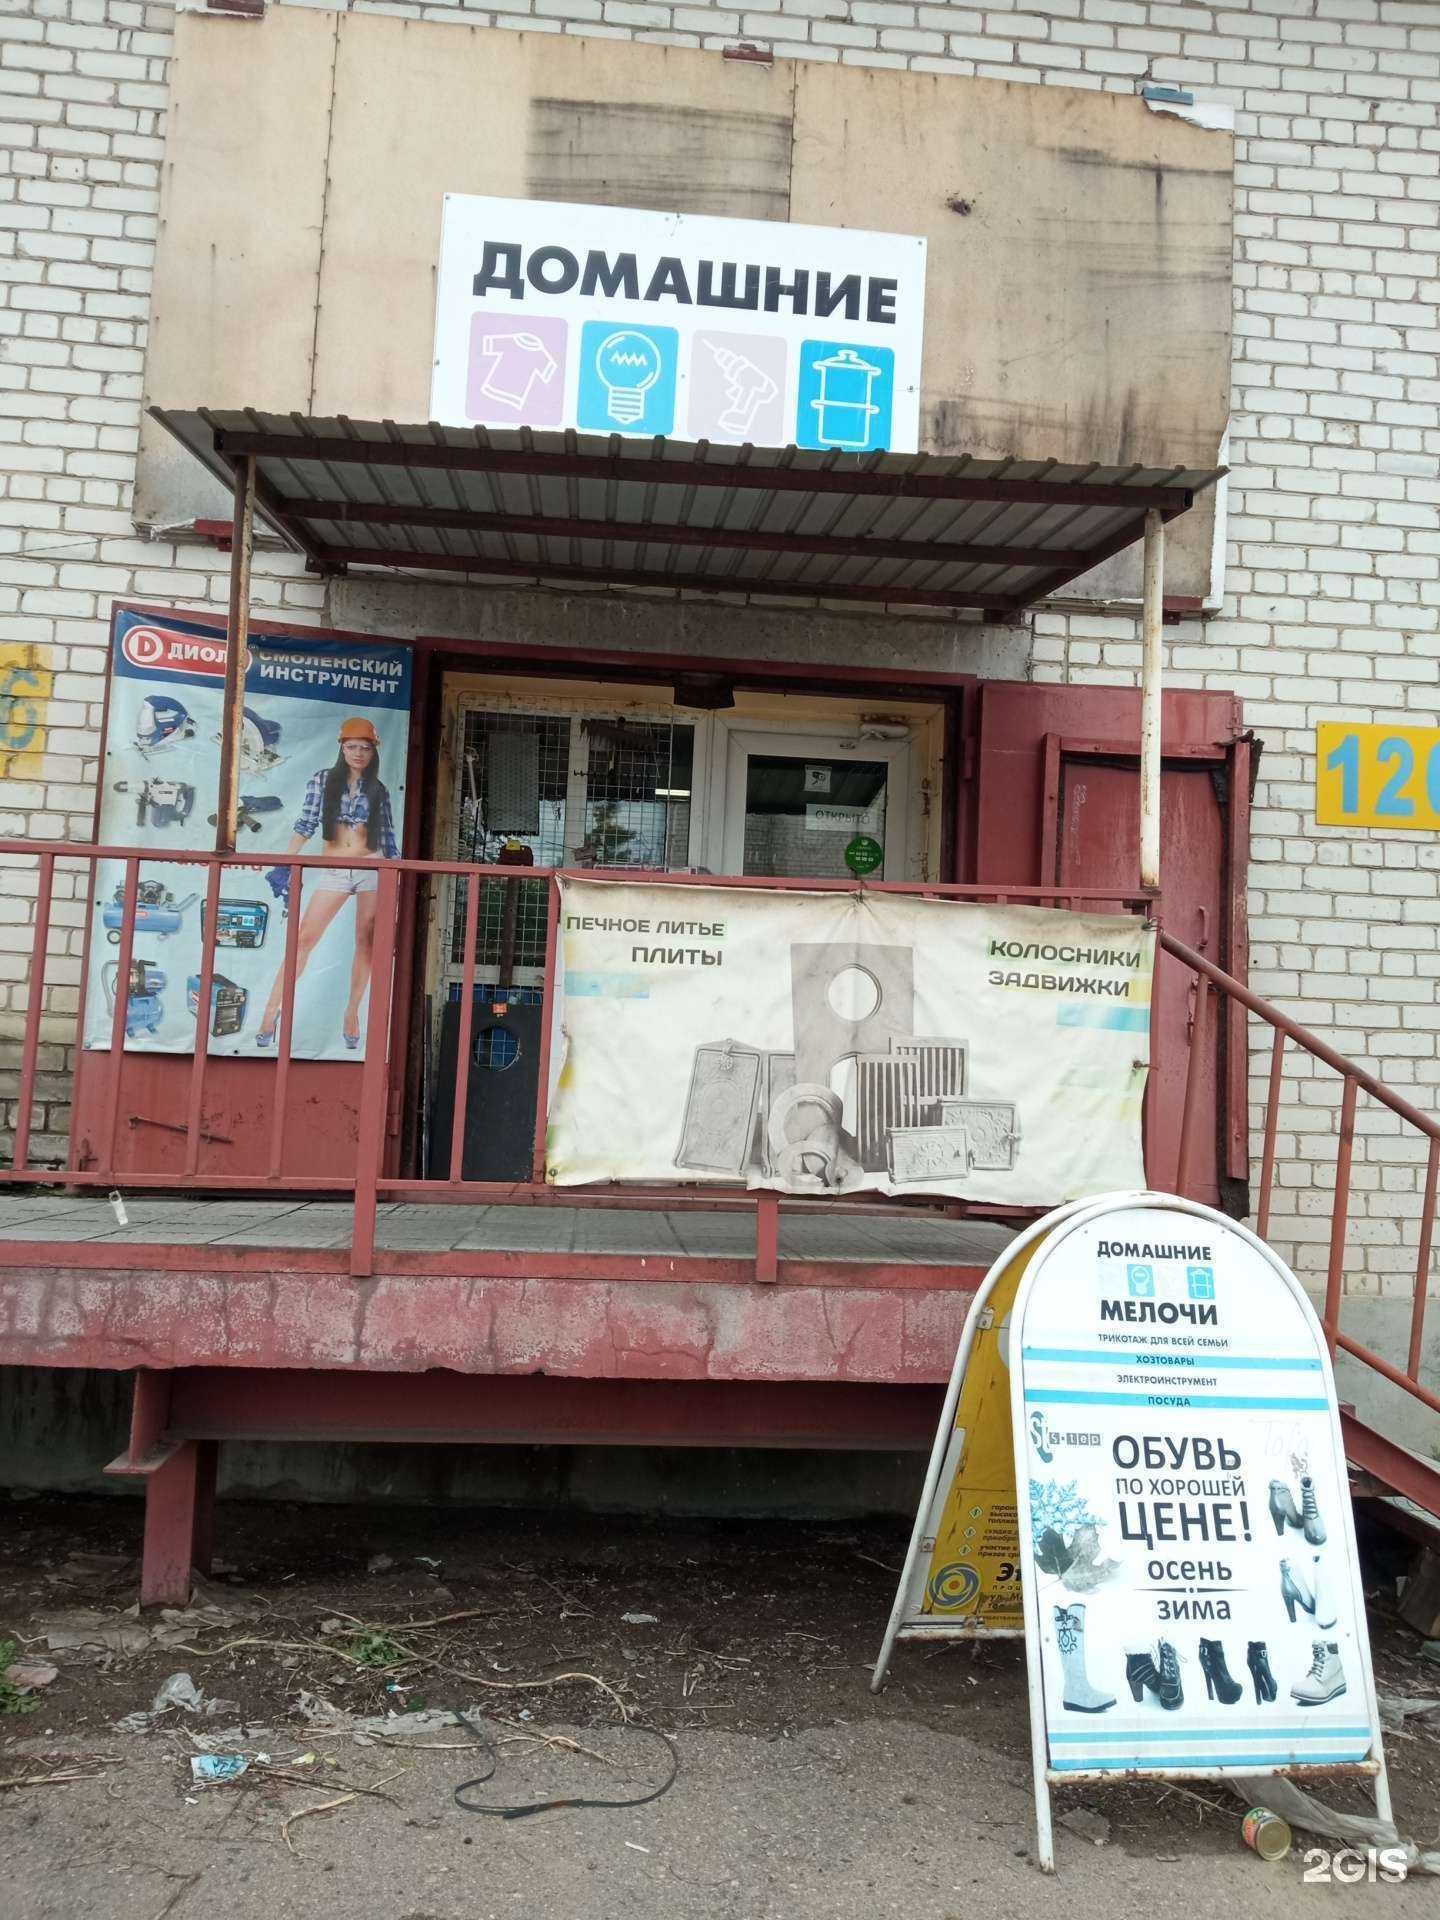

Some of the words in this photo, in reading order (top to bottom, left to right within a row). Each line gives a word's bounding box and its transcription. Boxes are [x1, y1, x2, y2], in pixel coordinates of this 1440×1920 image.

[472, 241, 898, 324] ДОМАШНИЕ
[167, 642, 228, 664] ДИОЛ
[259, 651, 402, 677] СМОЛЕНСКИЙ
[260, 664, 399, 694] ИНСТРУМЕНТ
[566, 916, 650, 934] ПЕЧНОЕ
[656, 919, 725, 937] ЛИТЬЕ
[631, 946, 723, 967] ПЛИТЫ
[989, 940, 1141, 969] КОЛОСНИКИ
[988, 970, 1130, 998] ЗАДВИЖКИ
[1097, 1241, 1212, 1261] ДОМАШНИЕ
[1100, 1300, 1218, 1326] МЕЛОЧИ
[1098, 1333, 1148, 1344] ТРИКОТАЖ
[1150, 1336, 1169, 1346] ДЛЯ
[1171, 1335, 1195, 1347] ВСЕЙ
[1197, 1337, 1229, 1348] СЕМЬИ
[1136, 1355, 1195, 1366] ХОЗТОВАРЫ
[1117, 1375, 1217, 1386] ЭЛЕКТРОИНСТРУМЕНТ
[1148, 1396, 1191, 1407] ПОСУДА
[1112, 1435, 1242, 1471] ОБУВЬ
[1116, 1478, 1143, 1496] ПО
[1150, 1475, 1246, 1497] ХОРОШЕЙ
[1118, 1501, 1251, 1550] ЦЕНЕ!
[1148, 1559, 1232, 1581] осень
[1156, 1599, 1231, 1620] зима
